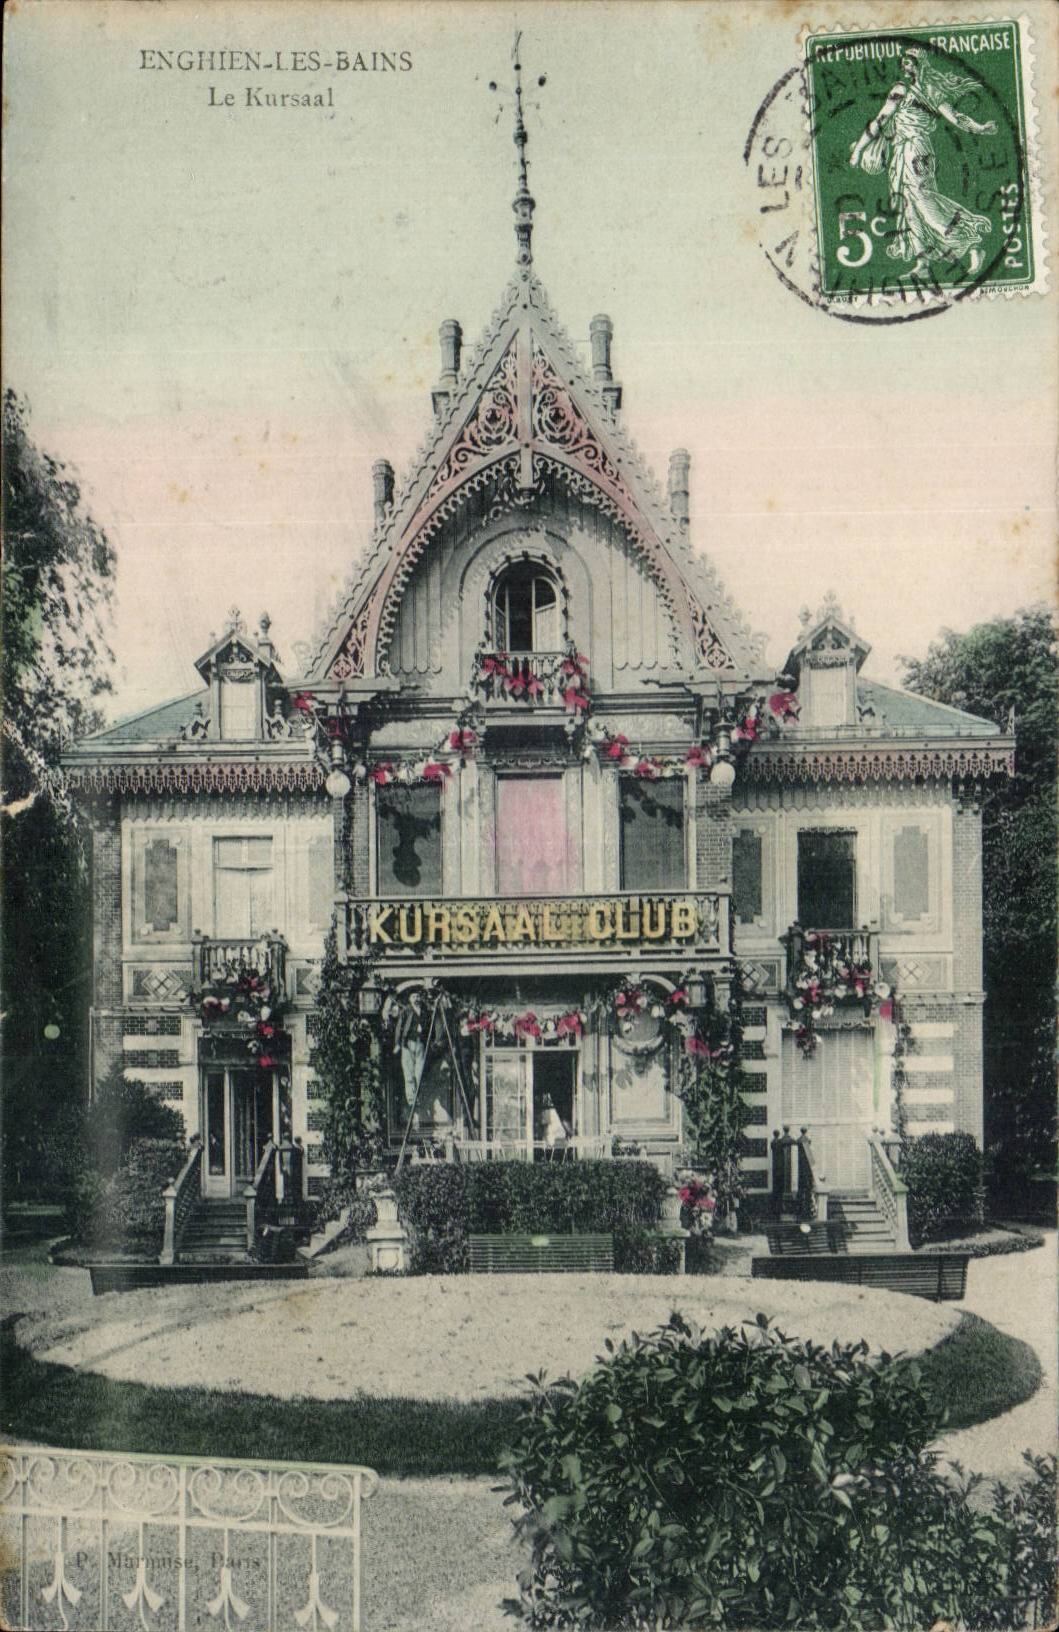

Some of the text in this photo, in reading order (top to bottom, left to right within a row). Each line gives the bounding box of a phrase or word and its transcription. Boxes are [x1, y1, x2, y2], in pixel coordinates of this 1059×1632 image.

[928, 31, 1012, 55] FRANÇAISE
[1000, 182, 1024, 268] POSTES
[368, 901, 697, 944] KURSAAL CLUB
